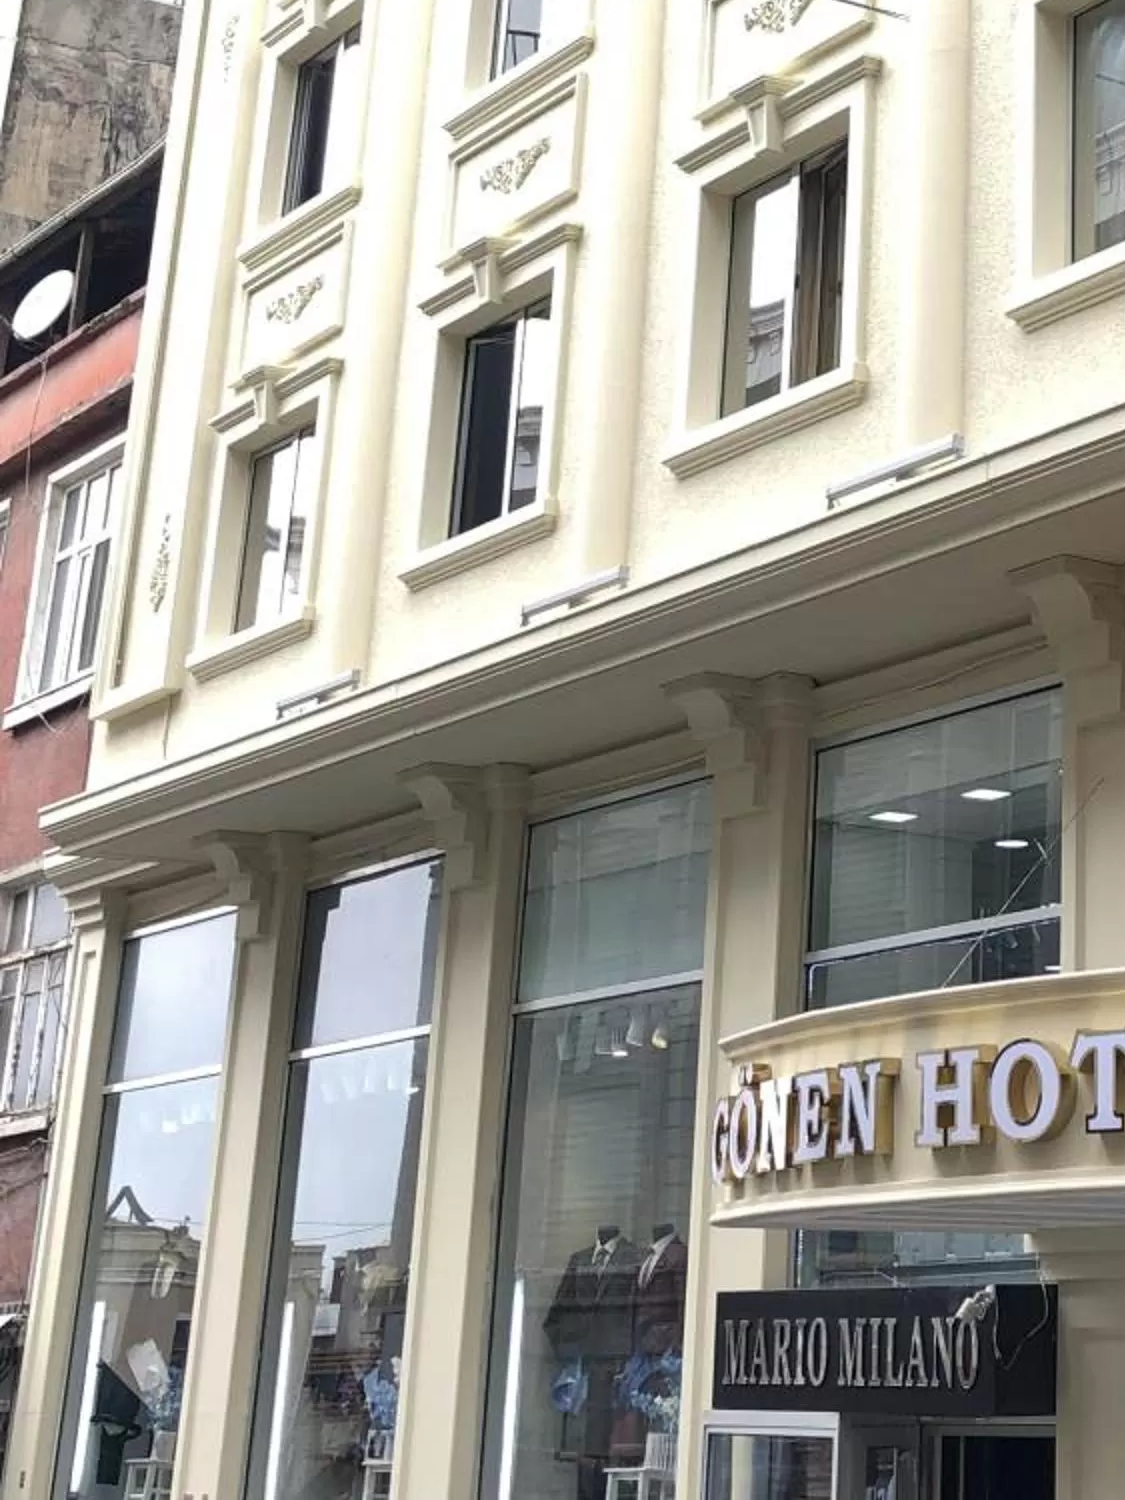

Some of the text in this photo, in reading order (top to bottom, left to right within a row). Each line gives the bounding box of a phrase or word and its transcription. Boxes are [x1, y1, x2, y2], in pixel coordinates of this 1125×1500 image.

[711, 1061, 897, 1184] GÖNEN
[721, 1315, 980, 1389] MARIO MILANO
